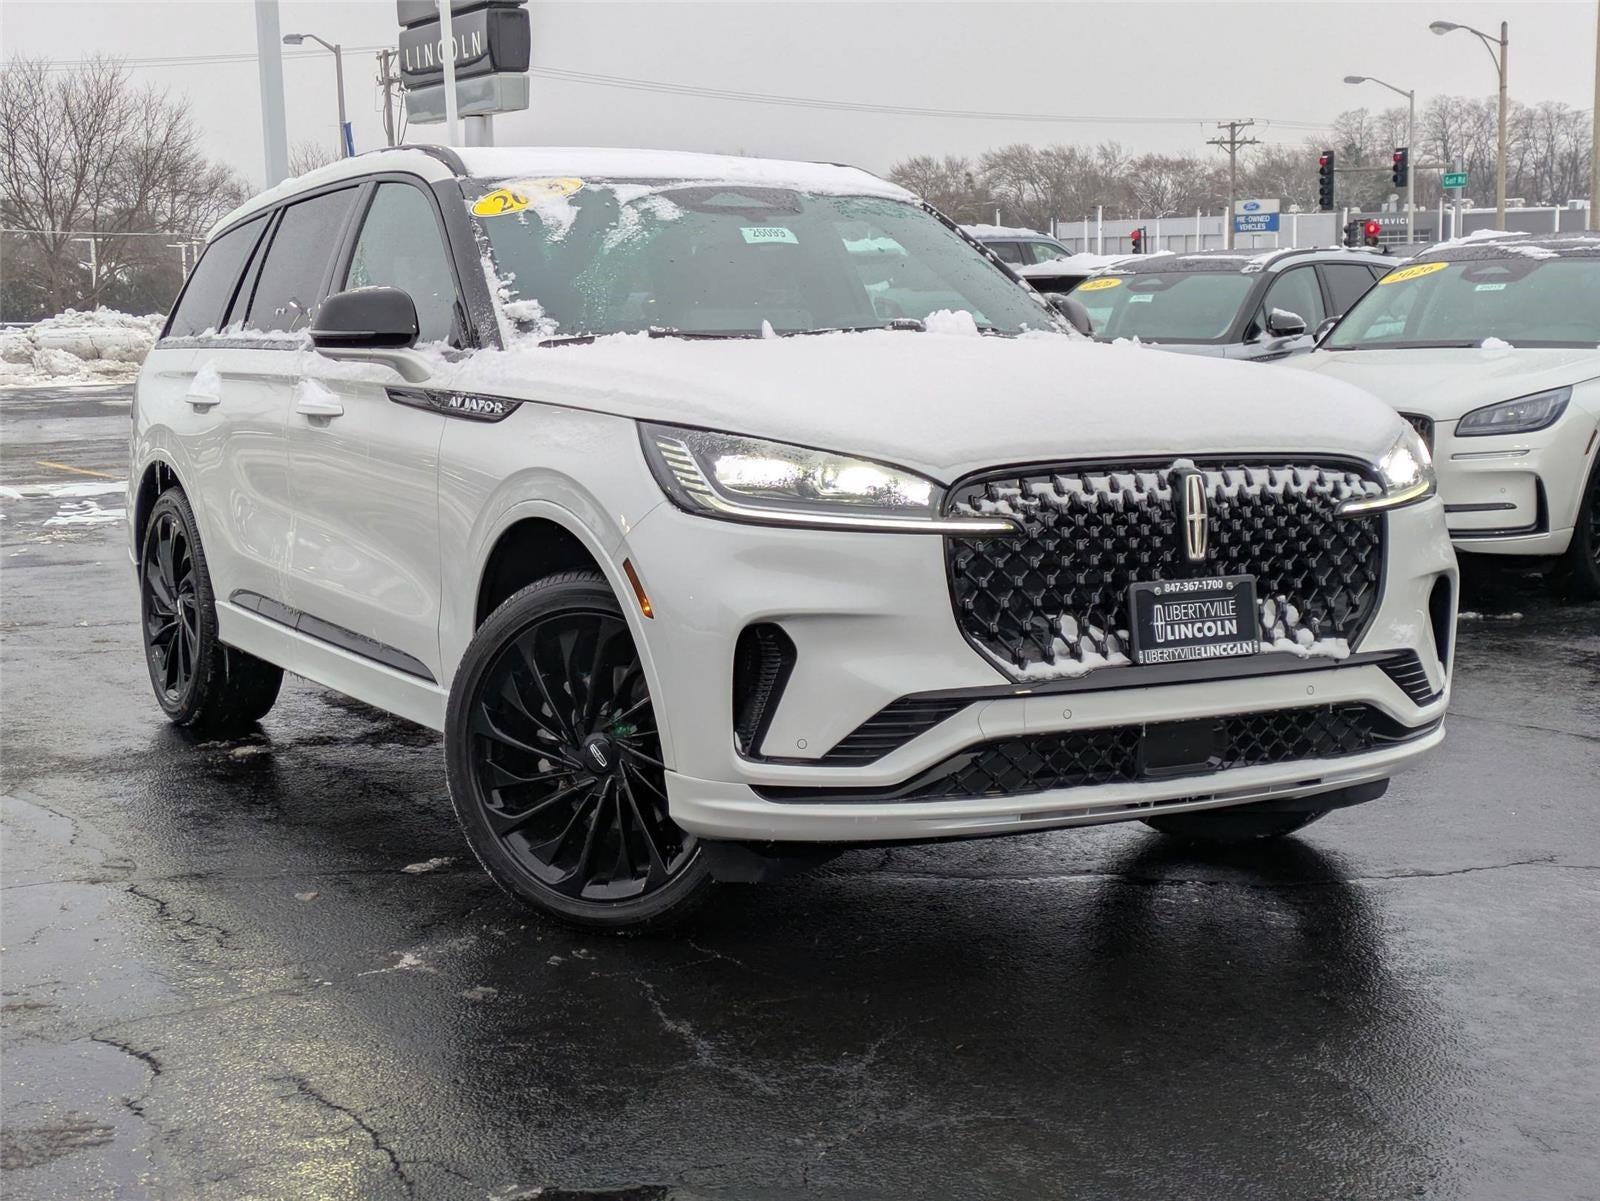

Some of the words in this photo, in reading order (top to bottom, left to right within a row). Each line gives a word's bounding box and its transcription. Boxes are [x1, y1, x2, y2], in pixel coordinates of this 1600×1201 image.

[1236, 215, 1271, 223] PRE-OWNED
[1240, 223, 1266, 231] VEHICLES
[1164, 580, 1223, 593] 847-367-1700
[1165, 600, 1237, 621] LIBERTYVILLE
[1166, 619, 1238, 641] LINCOLN
